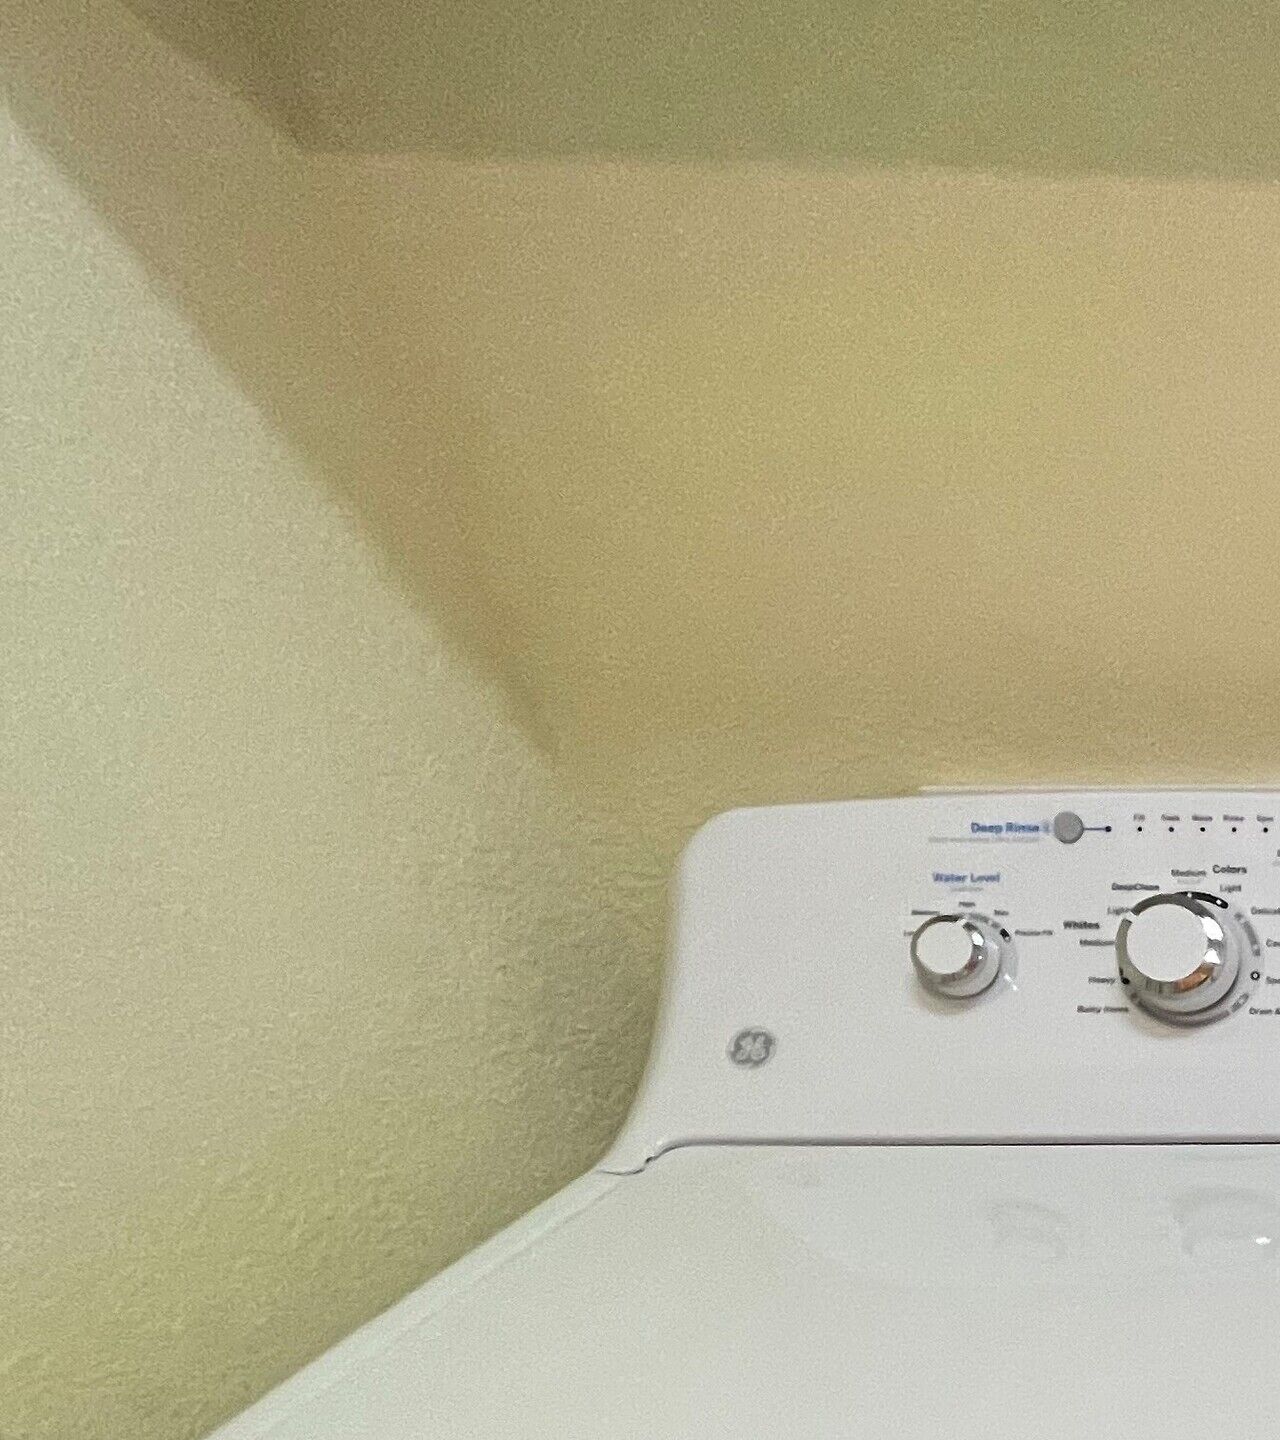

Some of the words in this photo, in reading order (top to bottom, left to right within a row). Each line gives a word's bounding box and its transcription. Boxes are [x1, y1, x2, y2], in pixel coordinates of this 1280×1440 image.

[970, 821, 1003, 834] Deep
[1005, 821, 1040, 833] Rinse
[1212, 864, 1248, 874] Colors
[932, 871, 967, 883] Water
[970, 871, 1000, 883] Level
[1062, 920, 1100, 930] Whites
